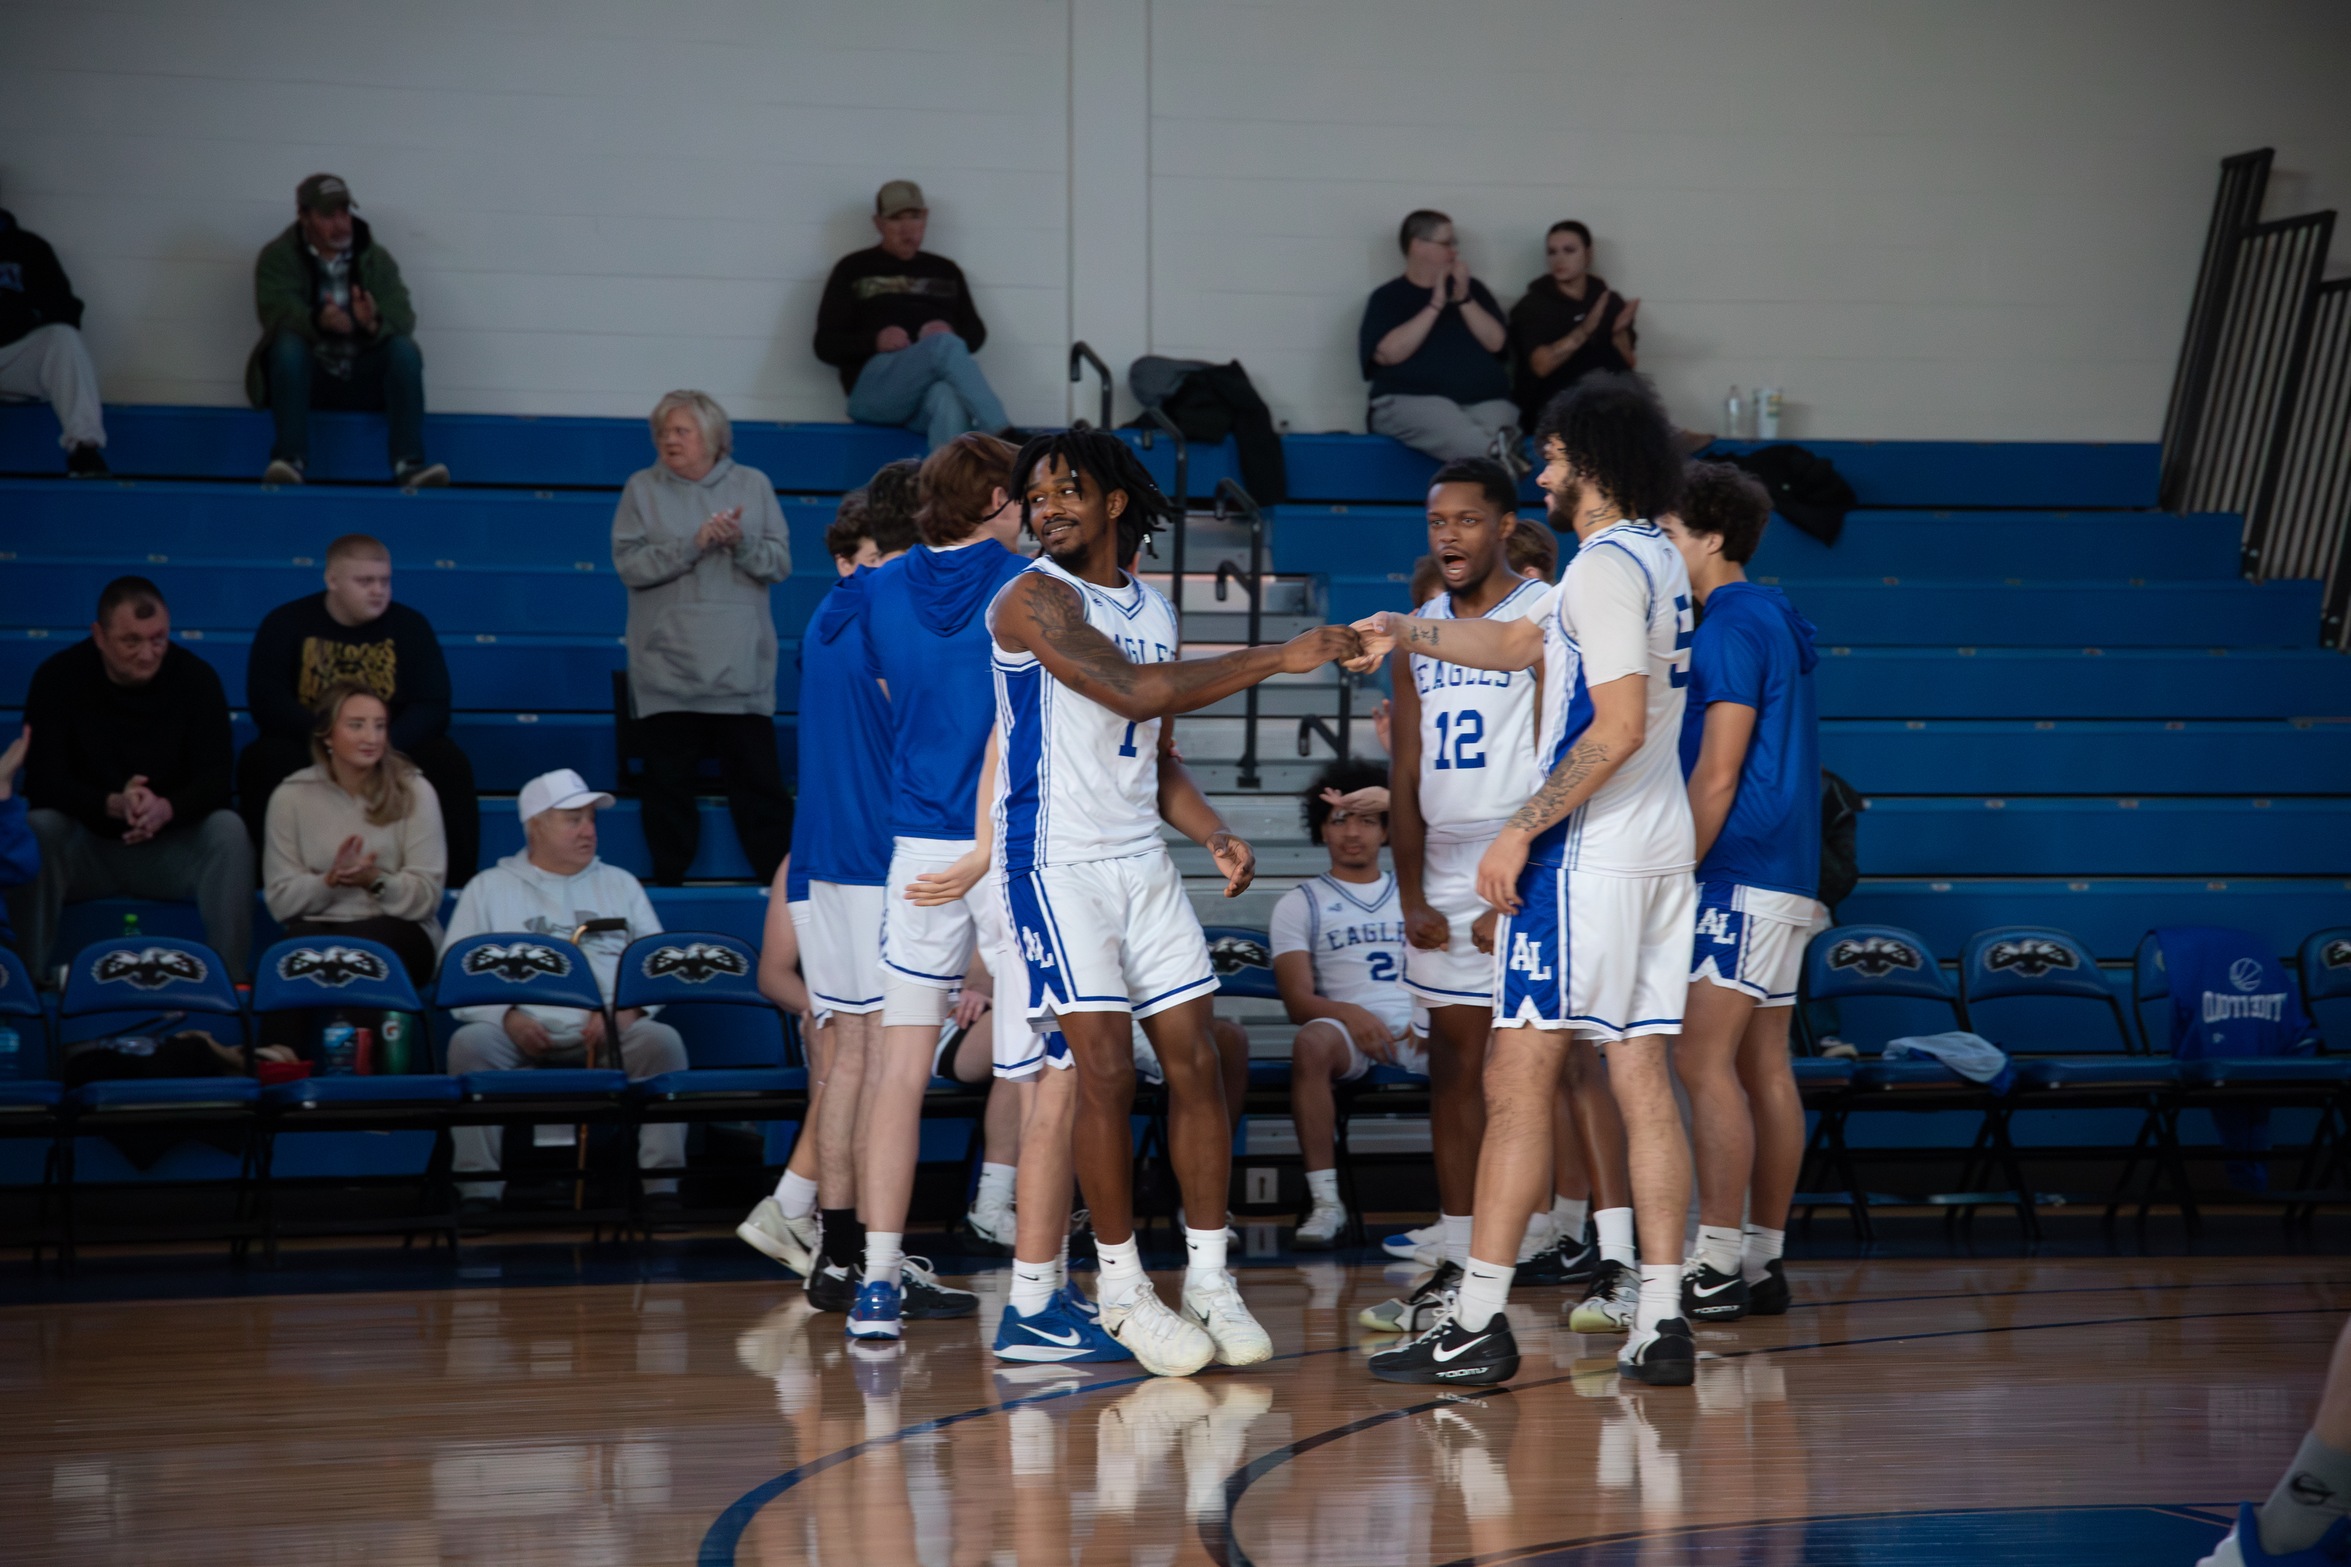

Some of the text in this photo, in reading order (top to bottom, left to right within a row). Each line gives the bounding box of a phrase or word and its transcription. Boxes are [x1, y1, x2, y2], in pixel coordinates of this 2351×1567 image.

[1434, 709, 1486, 770] 12
[1694, 907, 1736, 945] AL
[1366, 951, 1399, 981] 2
[1509, 932, 1551, 981] AL
